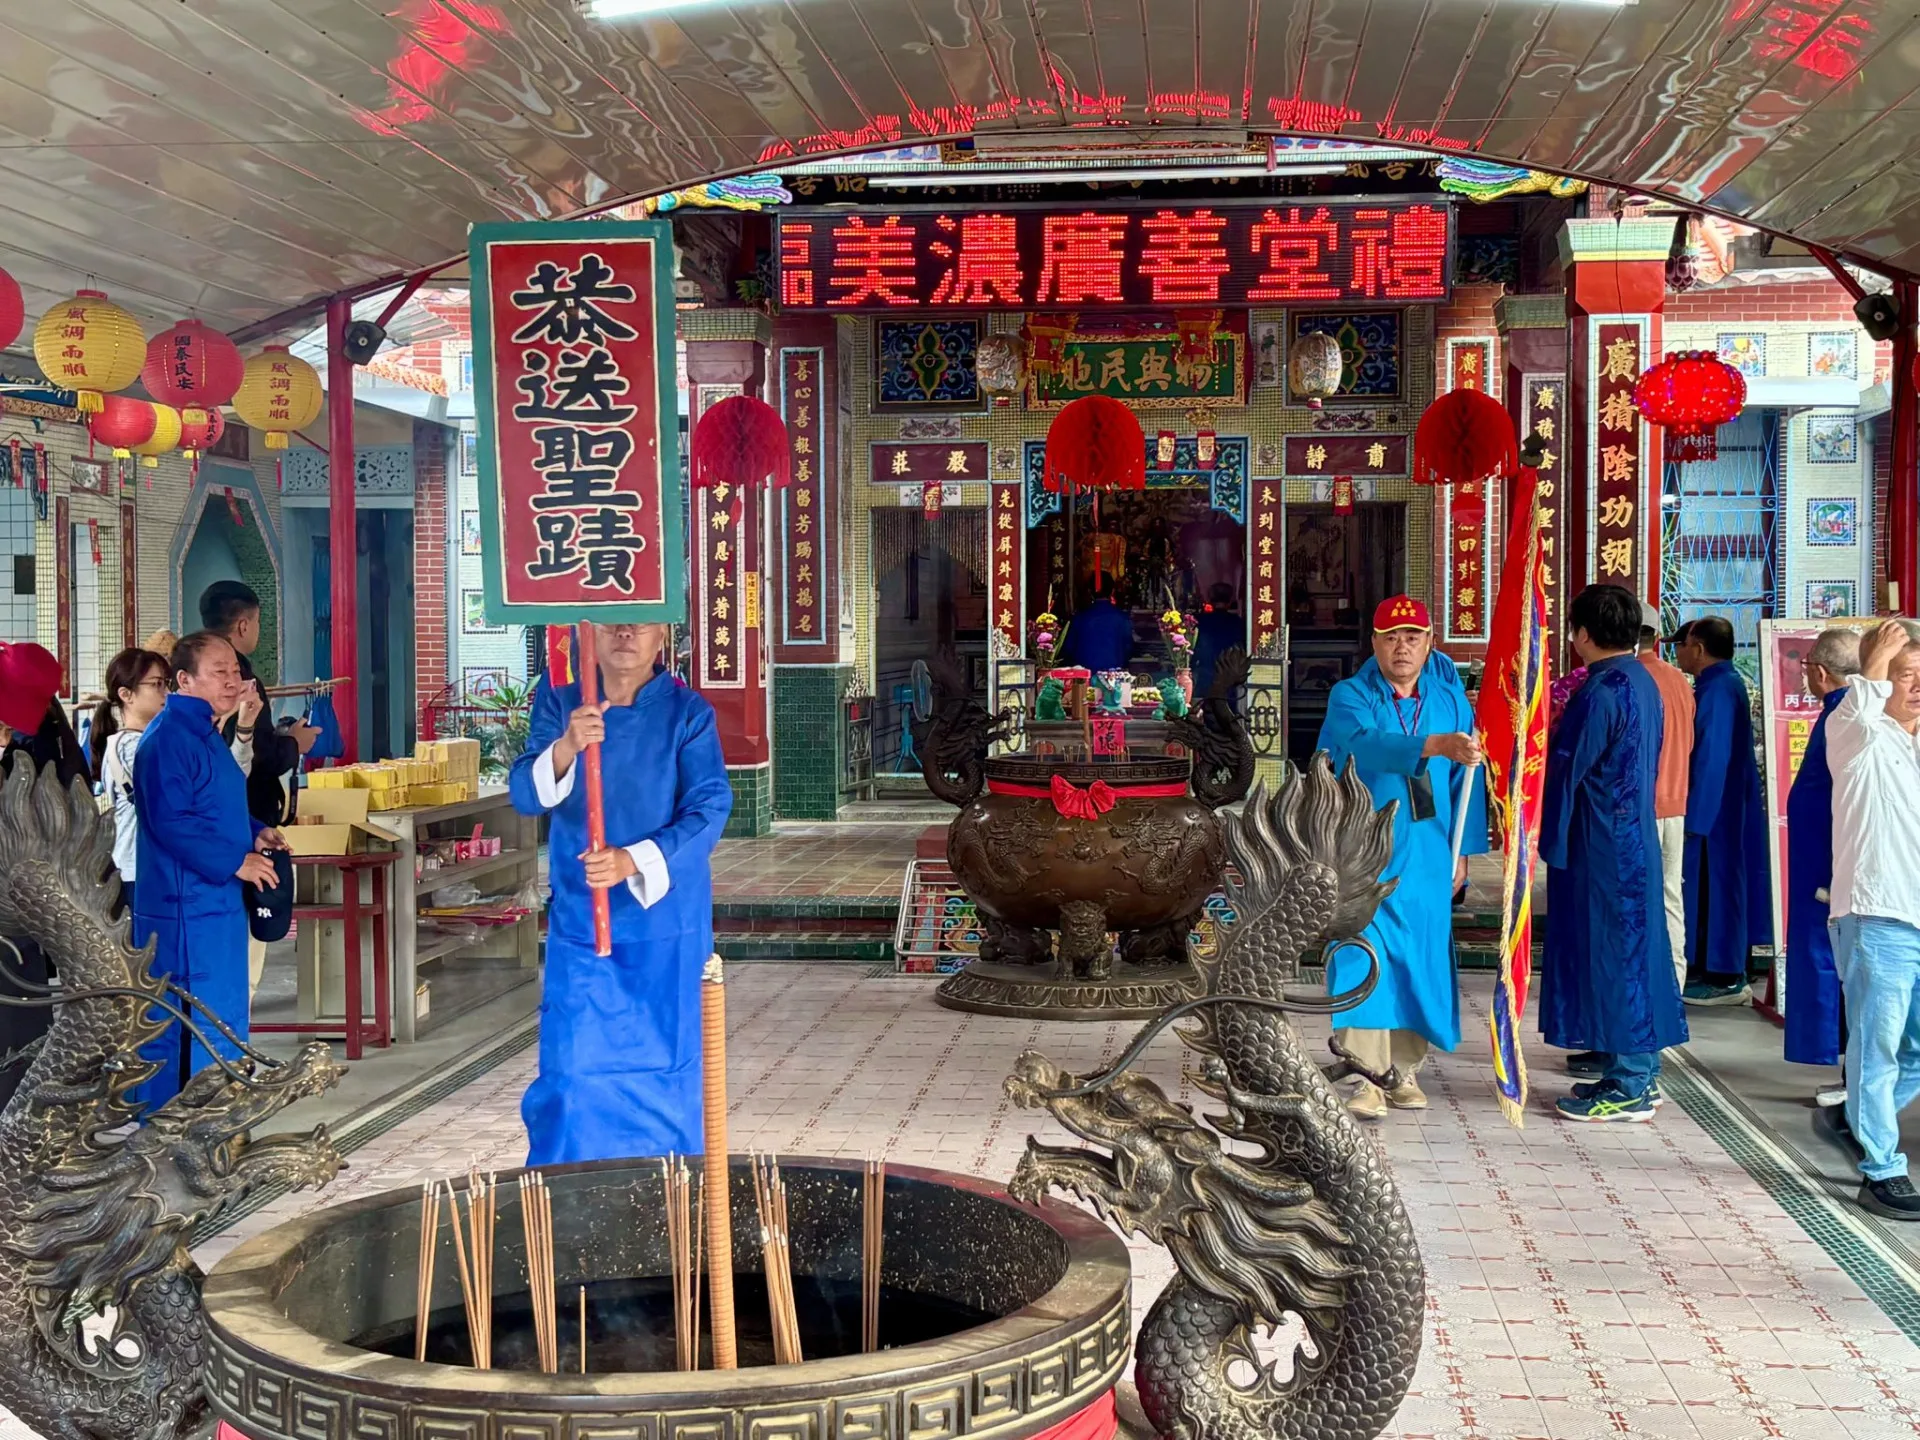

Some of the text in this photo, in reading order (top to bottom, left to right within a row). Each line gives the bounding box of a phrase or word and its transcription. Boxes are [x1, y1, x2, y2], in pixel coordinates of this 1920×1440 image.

[61, 307, 88, 377] 風調雨順
[174, 335, 194, 390] 國泰民安
[269, 362, 292, 420] 風調雨順
[511, 254, 645, 594] 恭送聖蹟
[1785, 694, 1824, 708] 丙午
